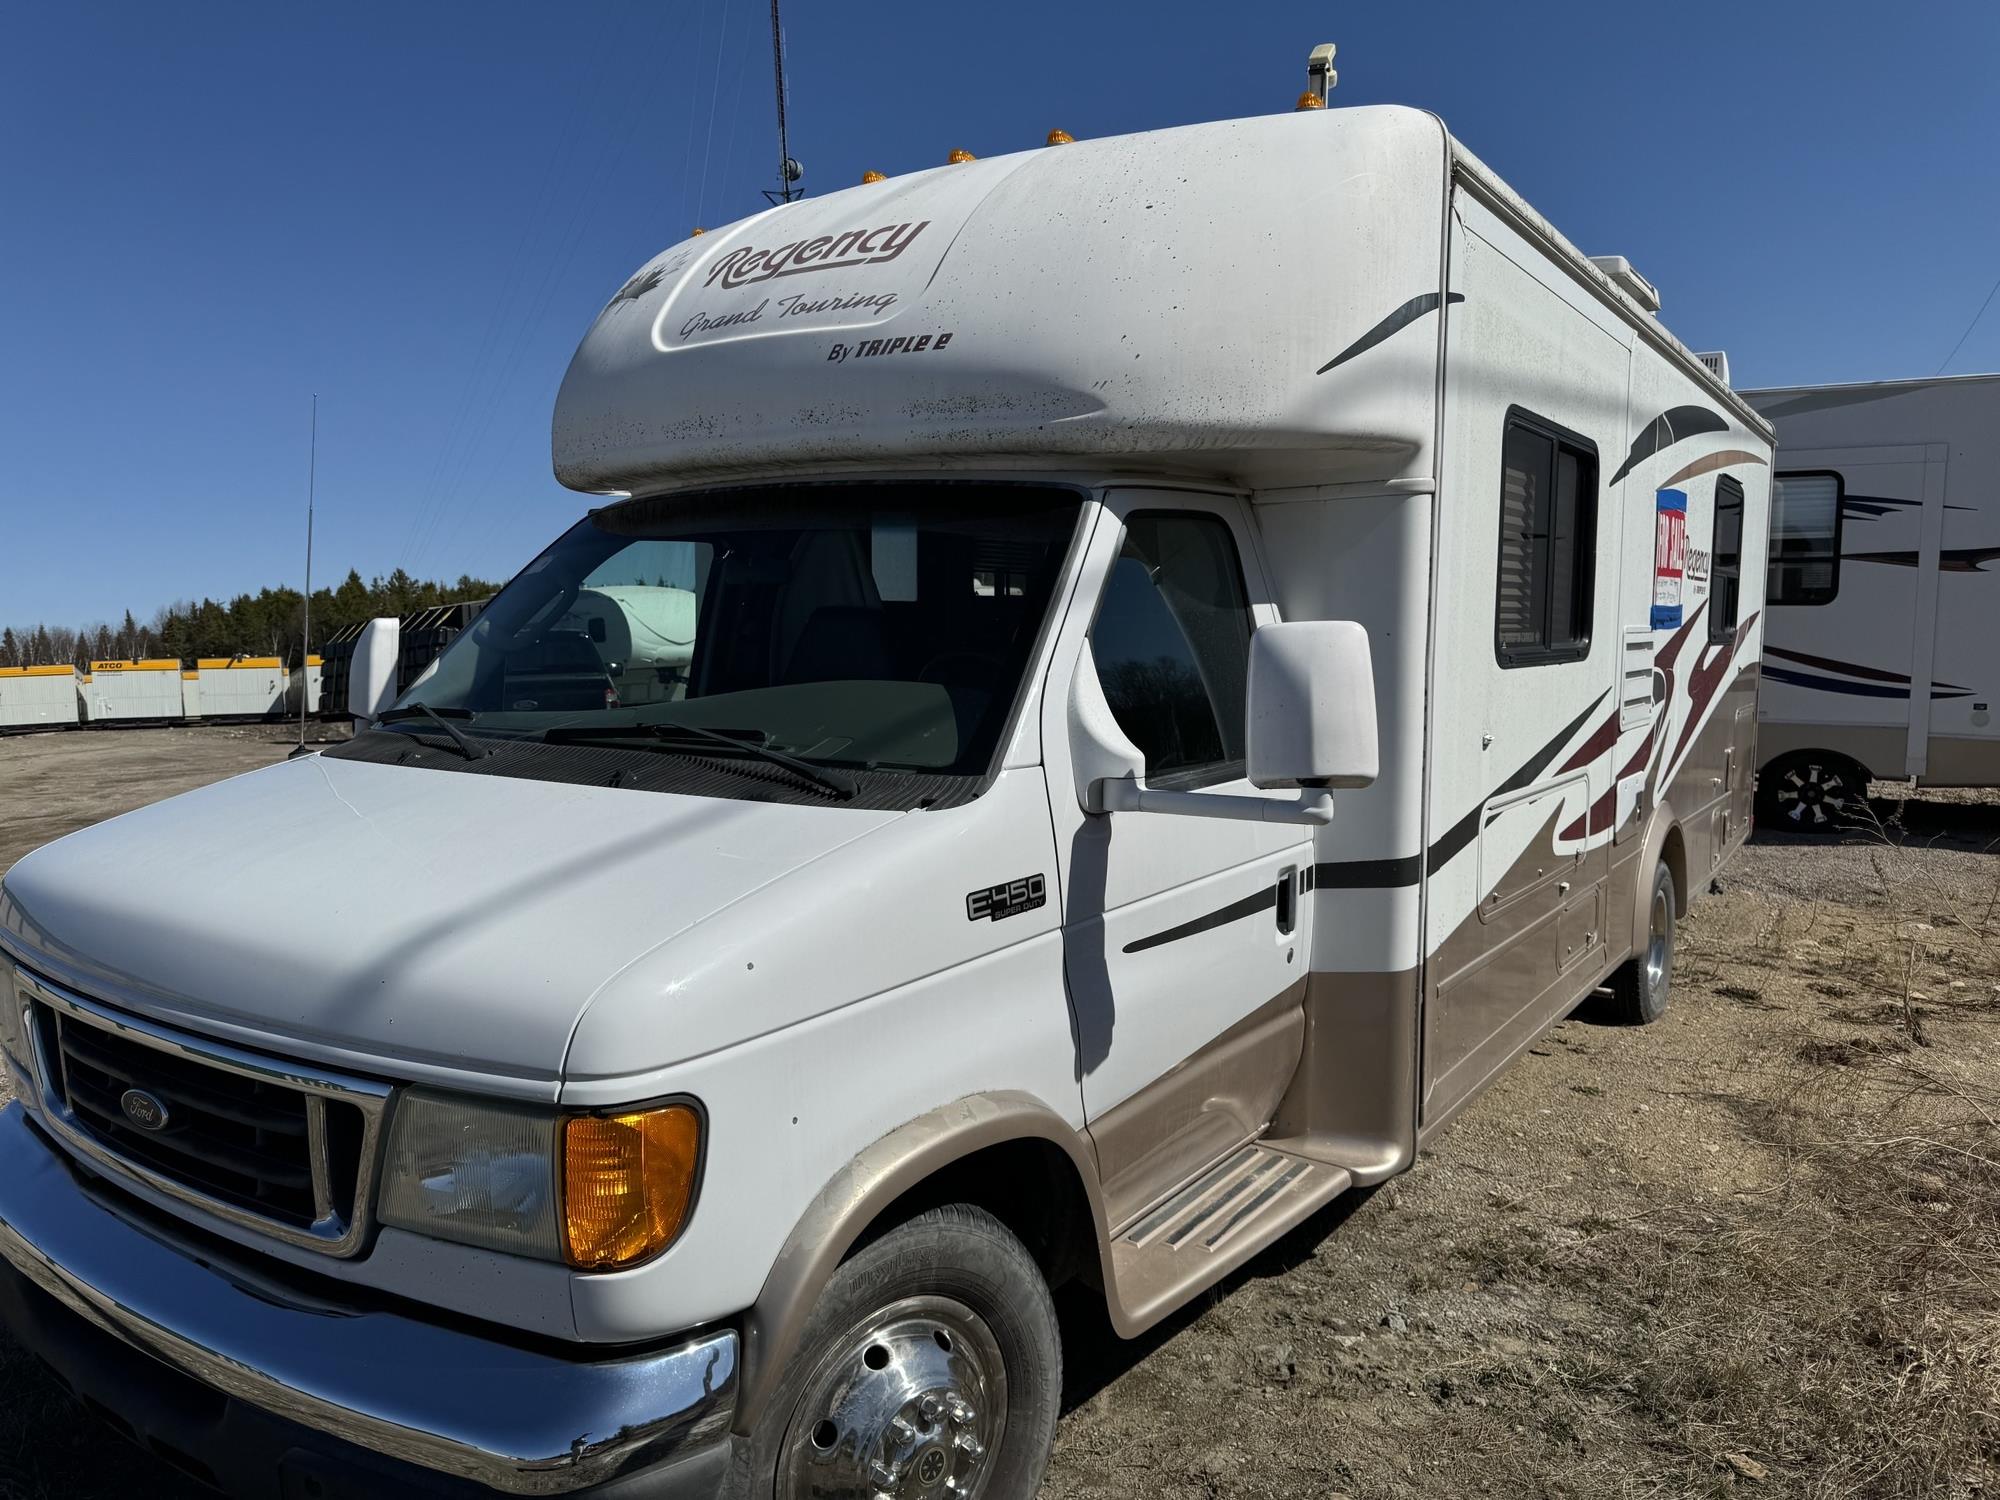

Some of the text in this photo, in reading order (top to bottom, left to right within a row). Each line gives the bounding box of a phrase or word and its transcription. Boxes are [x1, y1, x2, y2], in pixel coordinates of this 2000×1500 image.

[703, 220, 932, 290] Regency
[680, 291, 899, 341] Grand Touring
[827, 343, 854, 364] By
[995, 898, 1043, 919] SUPER DUTY
[130, 1097, 154, 1121] Ford
